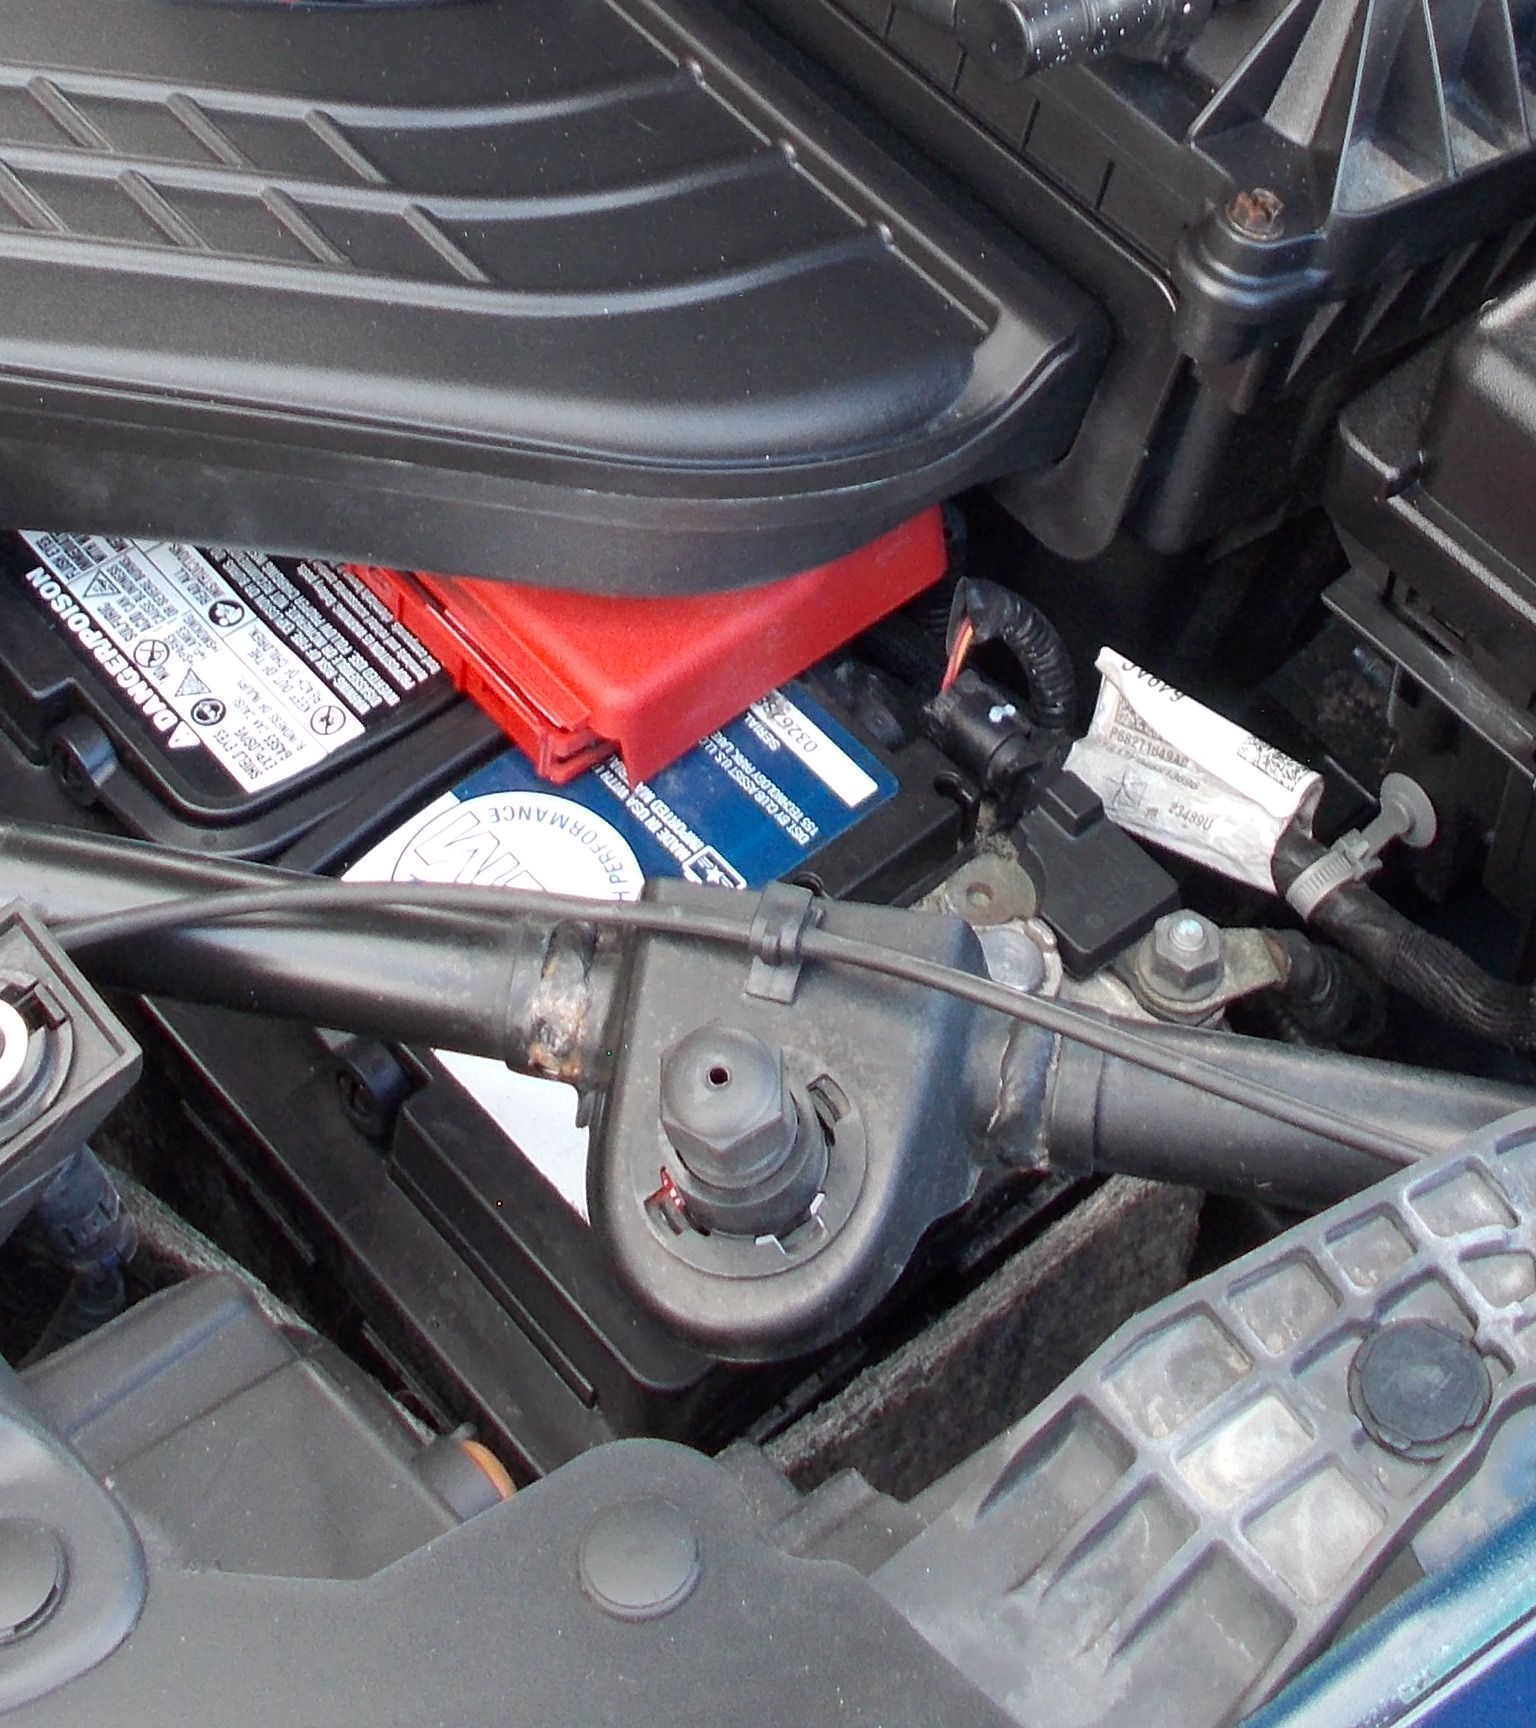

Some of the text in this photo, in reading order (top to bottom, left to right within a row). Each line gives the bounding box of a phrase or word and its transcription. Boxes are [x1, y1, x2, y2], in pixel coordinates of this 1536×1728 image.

[105, 563, 146, 603] BLINDNESS
[137, 578, 169, 607] SEVERE
[173, 567, 212, 605] READ ALL
[95, 601, 138, 642] SULFURIC
[114, 595, 153, 632] ACID CAN
[138, 600, 166, 625] CAUSE
[161, 603, 180, 618] OR
[23, 565, 179, 730] DANGER/POISON
[741, 712, 783, 750] SERIAL
[211, 728, 263, 780] SHIELD EYES
[233, 726, 278, 770] EXPLOSIVE
[598, 769, 631, 799] WITH
[726, 765, 761, 794] ASSIST
[749, 768, 806, 820] TECHNOLOGY
[623, 795, 652, 820] USA
[752, 790, 780, 813] CLUB
[771, 809, 792, 825] BY
[643, 816, 664, 832] IN
[649, 798, 705, 850] IMPORTED
[783, 821, 811, 844] DIST.
[798, 816, 821, 835] 155
[487, 804, 628, 885] PERFORMANCE
[654, 827, 692, 860] MADE
